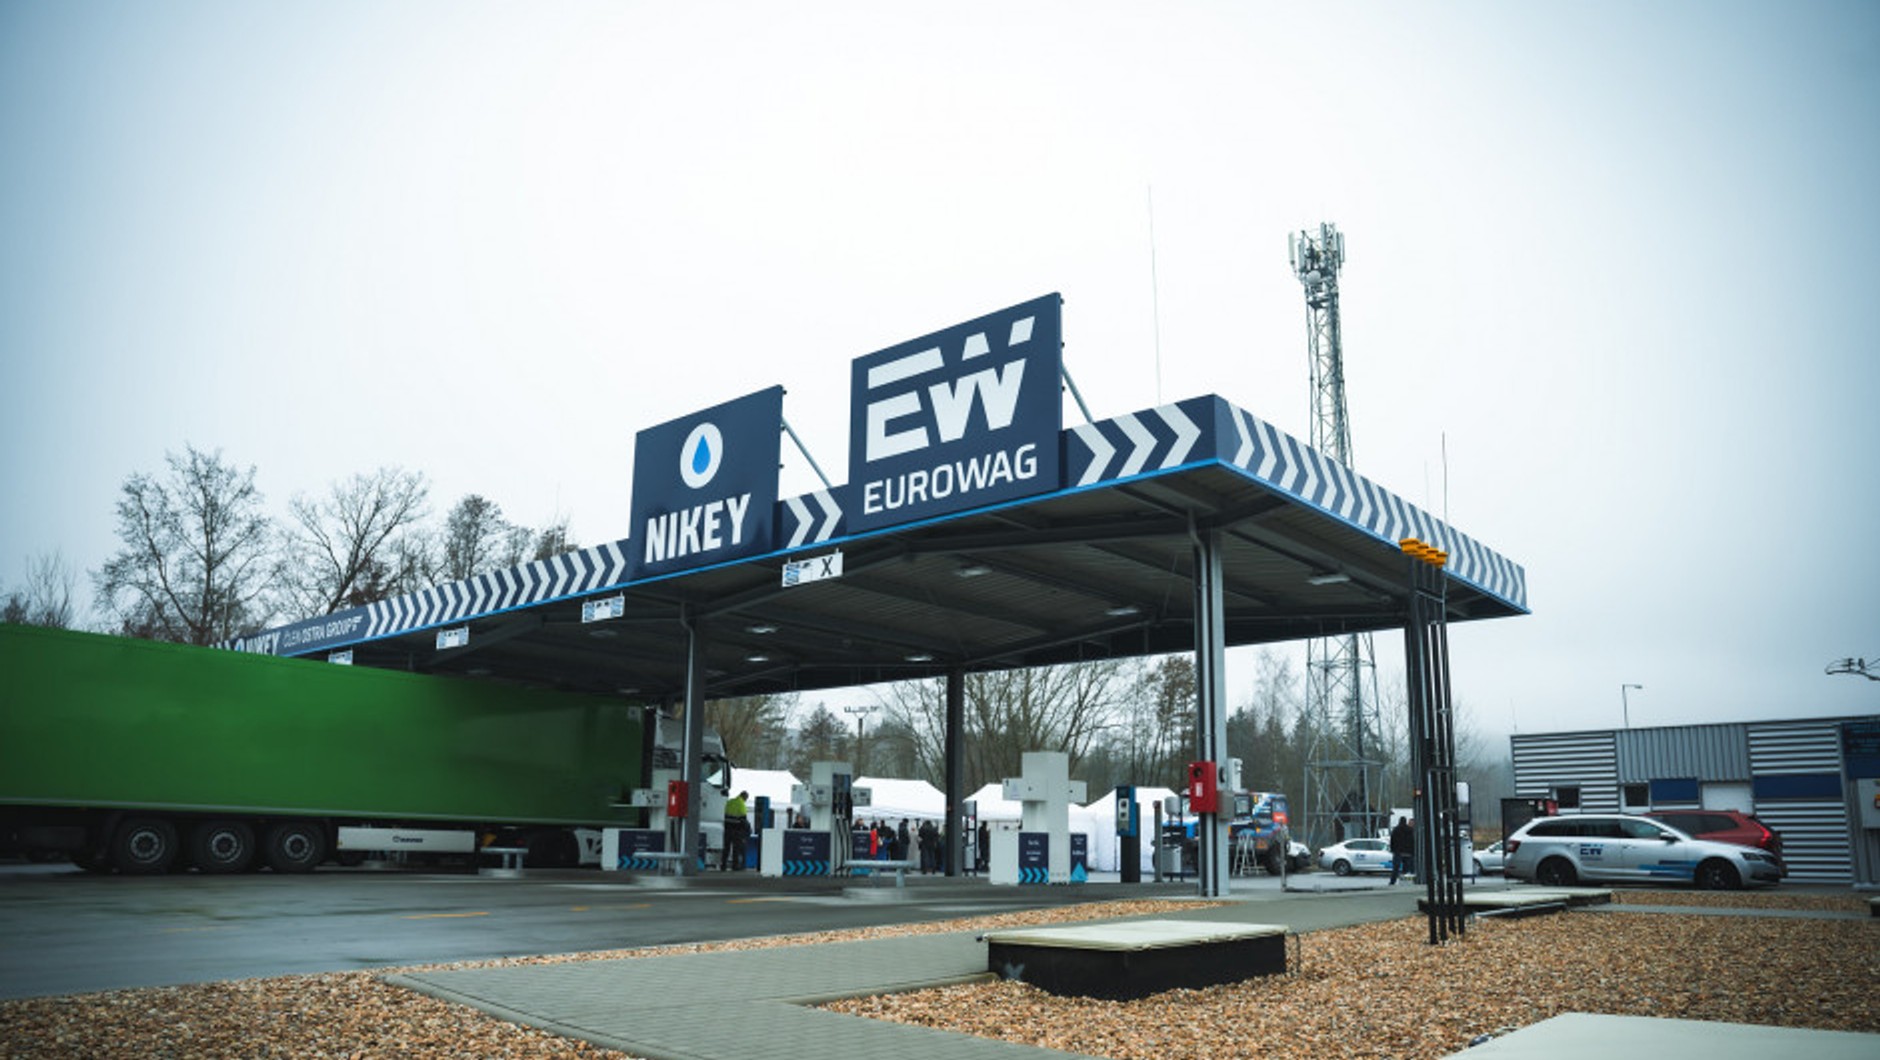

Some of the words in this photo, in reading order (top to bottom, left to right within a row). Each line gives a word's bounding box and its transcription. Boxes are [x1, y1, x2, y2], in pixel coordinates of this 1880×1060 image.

[866, 316, 1035, 463] EW
[864, 443, 1037, 515] EUROWAG
[645, 493, 751, 564] NIKEY
[820, 556, 834, 578] X
